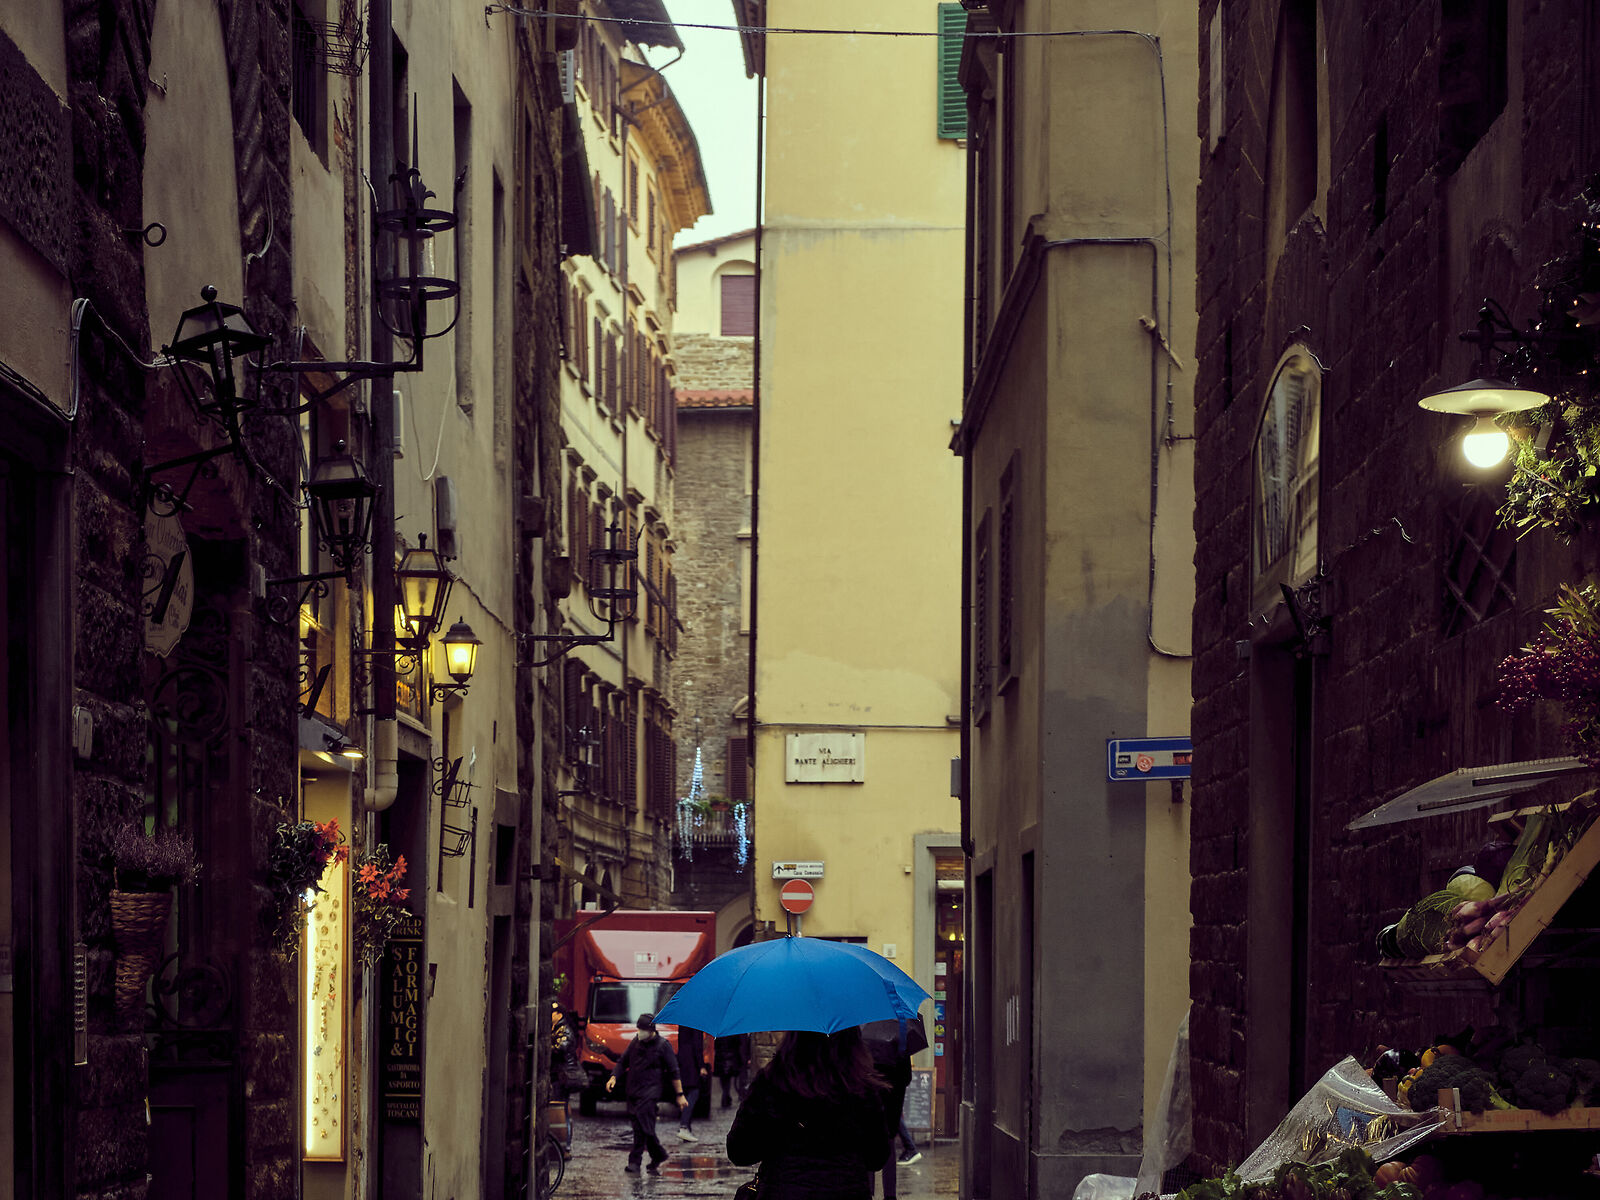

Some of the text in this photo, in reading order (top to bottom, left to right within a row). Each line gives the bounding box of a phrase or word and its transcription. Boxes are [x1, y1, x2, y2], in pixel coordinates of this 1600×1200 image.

[390, 946, 405, 1057] SALUMI &
[404, 946, 419, 1057] FORMAGGI
[386, 1080, 420, 1089] ASPORTO
[386, 1109, 419, 1118] TOSCANE
